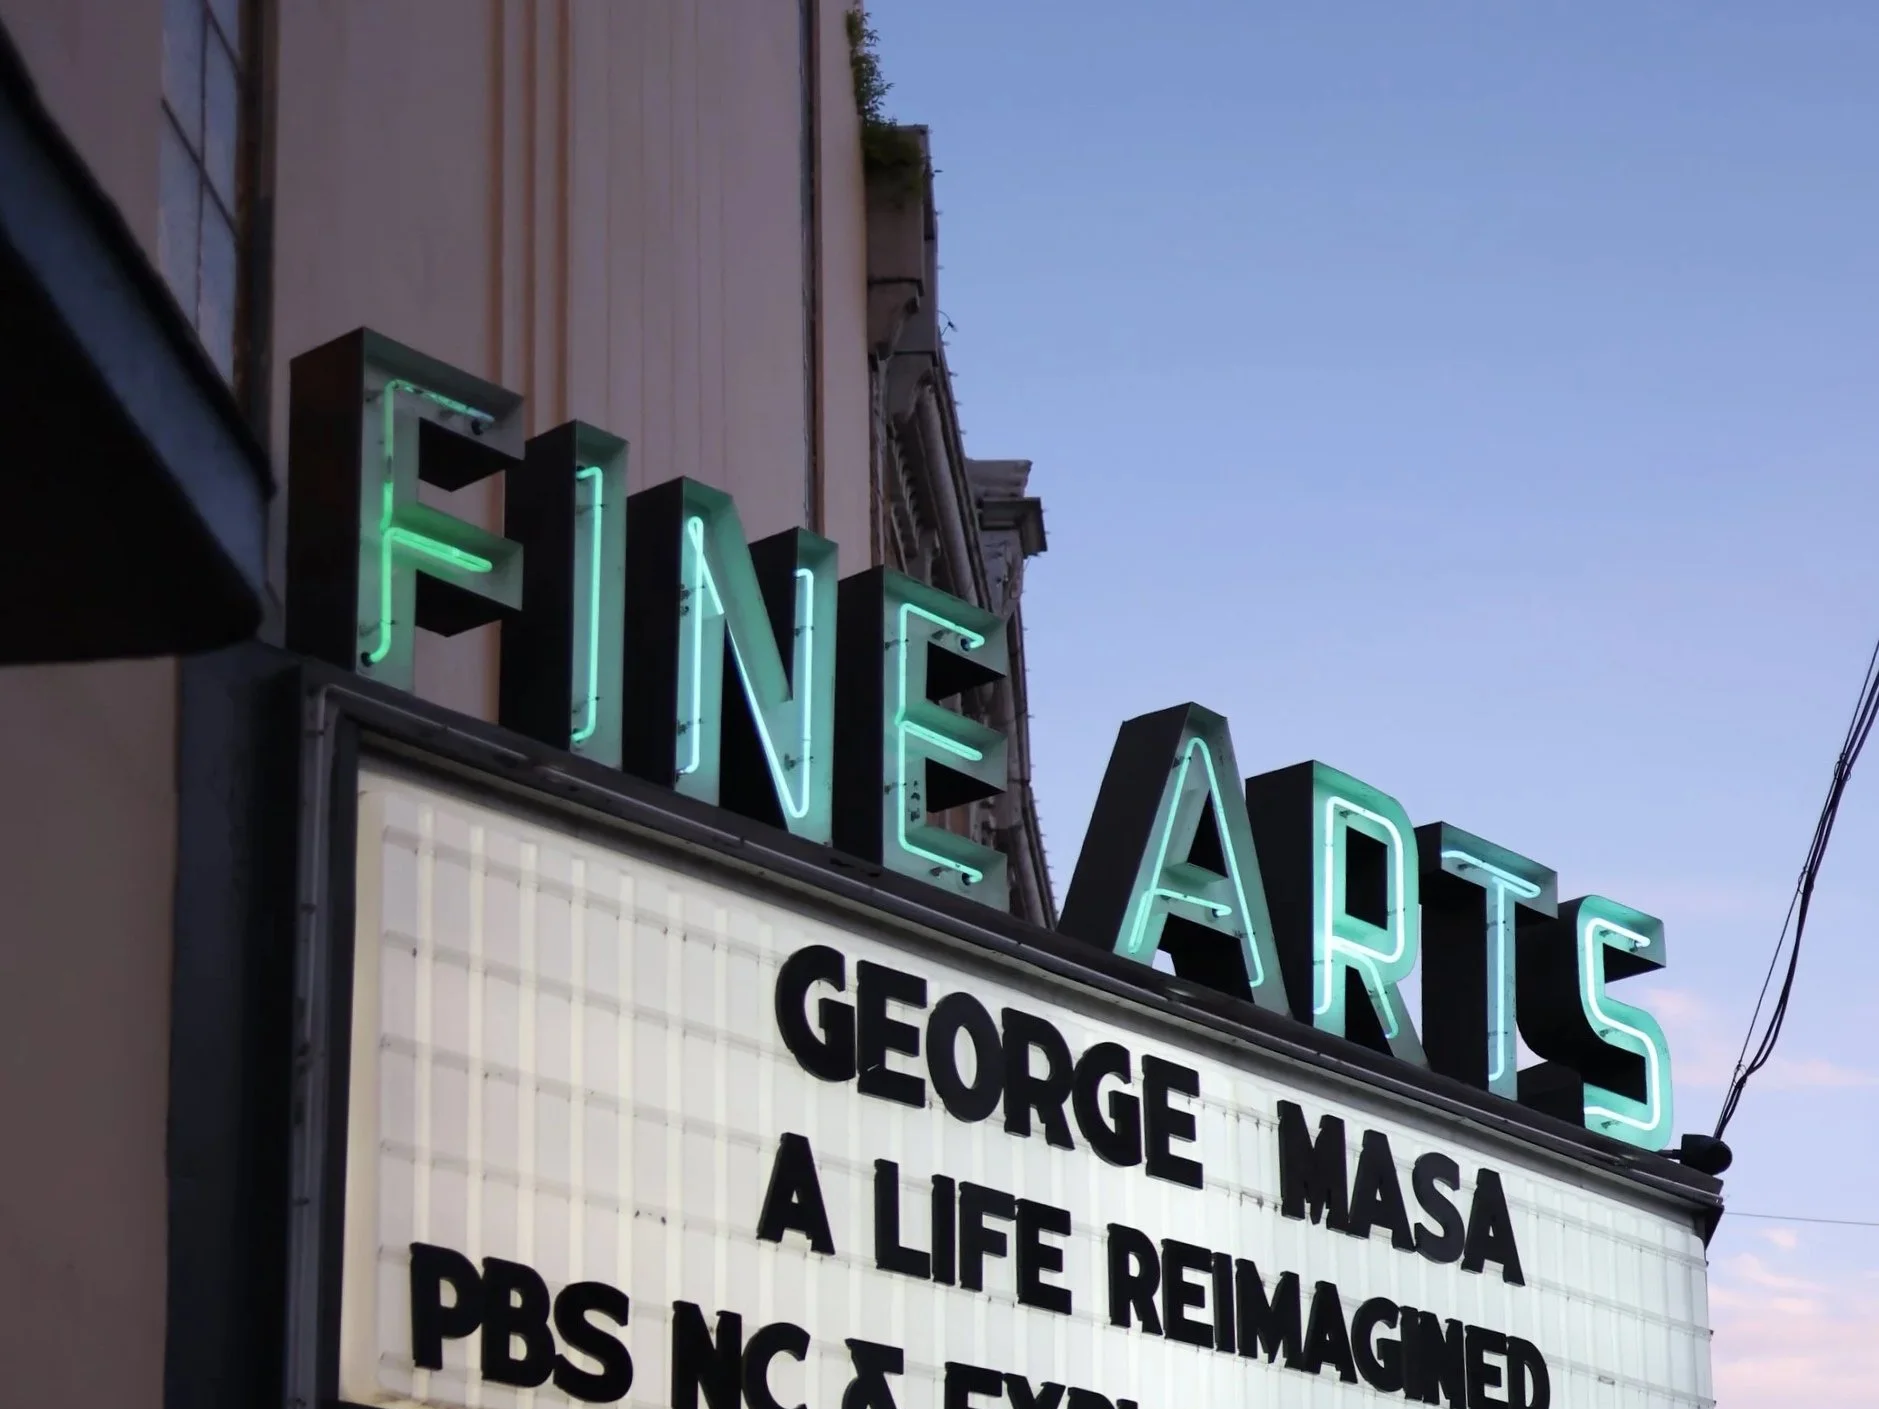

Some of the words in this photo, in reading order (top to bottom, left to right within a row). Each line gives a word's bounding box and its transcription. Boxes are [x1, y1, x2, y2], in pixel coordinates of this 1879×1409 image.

[290, 327, 1009, 911] FINE
[1057, 702, 1673, 1152] ARTS
[756, 1132, 835, 1255] A
[874, 1158, 1072, 1315] LIFE
[774, 944, 1203, 1190] GEORGE
[1276, 1100, 1525, 1286] MASA
[410, 1242, 634, 1403] PBS
